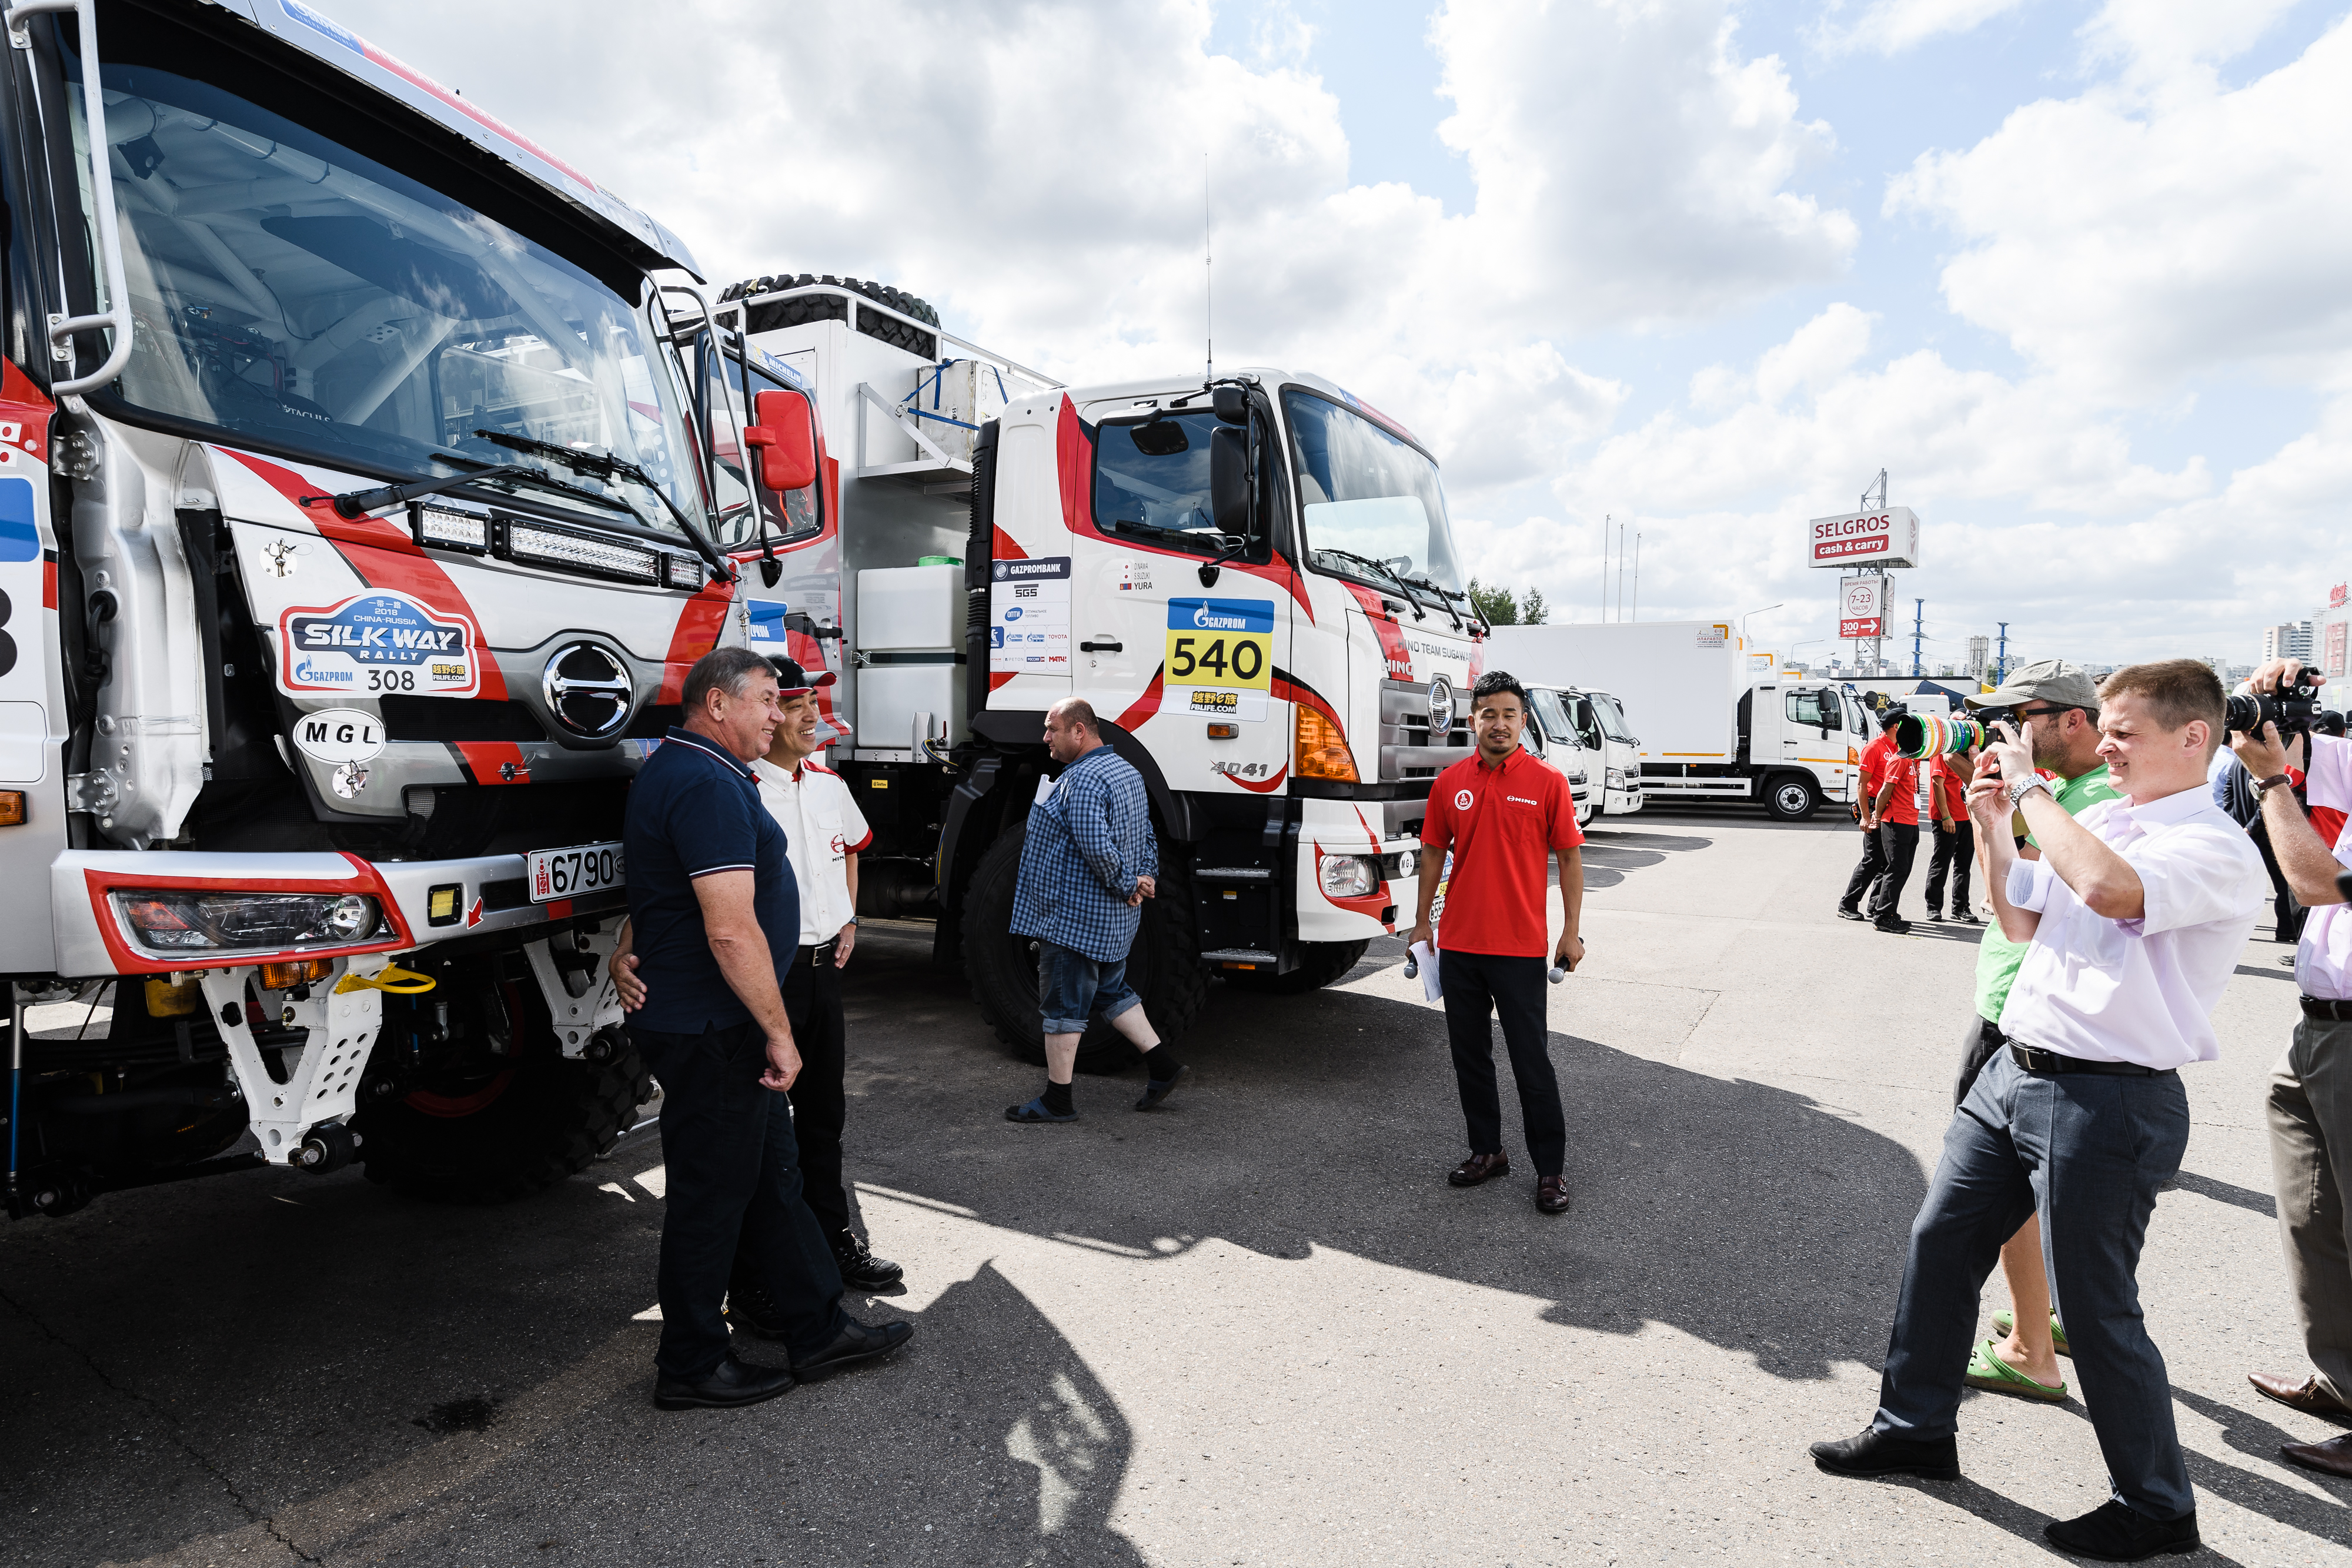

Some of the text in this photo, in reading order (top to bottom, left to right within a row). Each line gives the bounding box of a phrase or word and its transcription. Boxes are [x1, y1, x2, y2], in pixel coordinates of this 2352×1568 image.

[295, 12, 354, 48] GENERAL PARTNER
[362, 40, 475, 112] INTERNATIONAL
[589, 195, 654, 247] HINO
[769, 357, 801, 383] MICHELIN
[1815, 514, 1890, 539] SELGROS
[1819, 539, 1884, 555] cash & carry
[1010, 563, 1061, 575] GAZPROMBANK
[1134, 581, 1152, 590] YURA
[1015, 589, 1037, 598] SGS
[1851, 593, 1871, 604] 7-23
[368, 600, 402, 609] 一带一路
[1208, 617, 1247, 629] GAZPROM
[1842, 621, 1859, 631] 300
[303, 623, 457, 651] SILK WAY
[750, 624, 770, 638] ZPROM
[359, 650, 419, 661] RALLY
[1397, 637, 1476, 663] HINO TEAM SUGAWARA
[1172, 638, 1262, 680] 540
[432, 664, 466, 675] 越野e族
[1381, 658, 1414, 676] HINO
[314, 671, 353, 682] GAZPROM
[368, 670, 415, 691] 308
[1191, 691, 1238, 706] 越野e族
[1190, 704, 1237, 713] FBLIFE.COM
[1210, 761, 1268, 777] 4041
[1515, 797, 1538, 806] HINO
[551, 848, 614, 893] 6790
